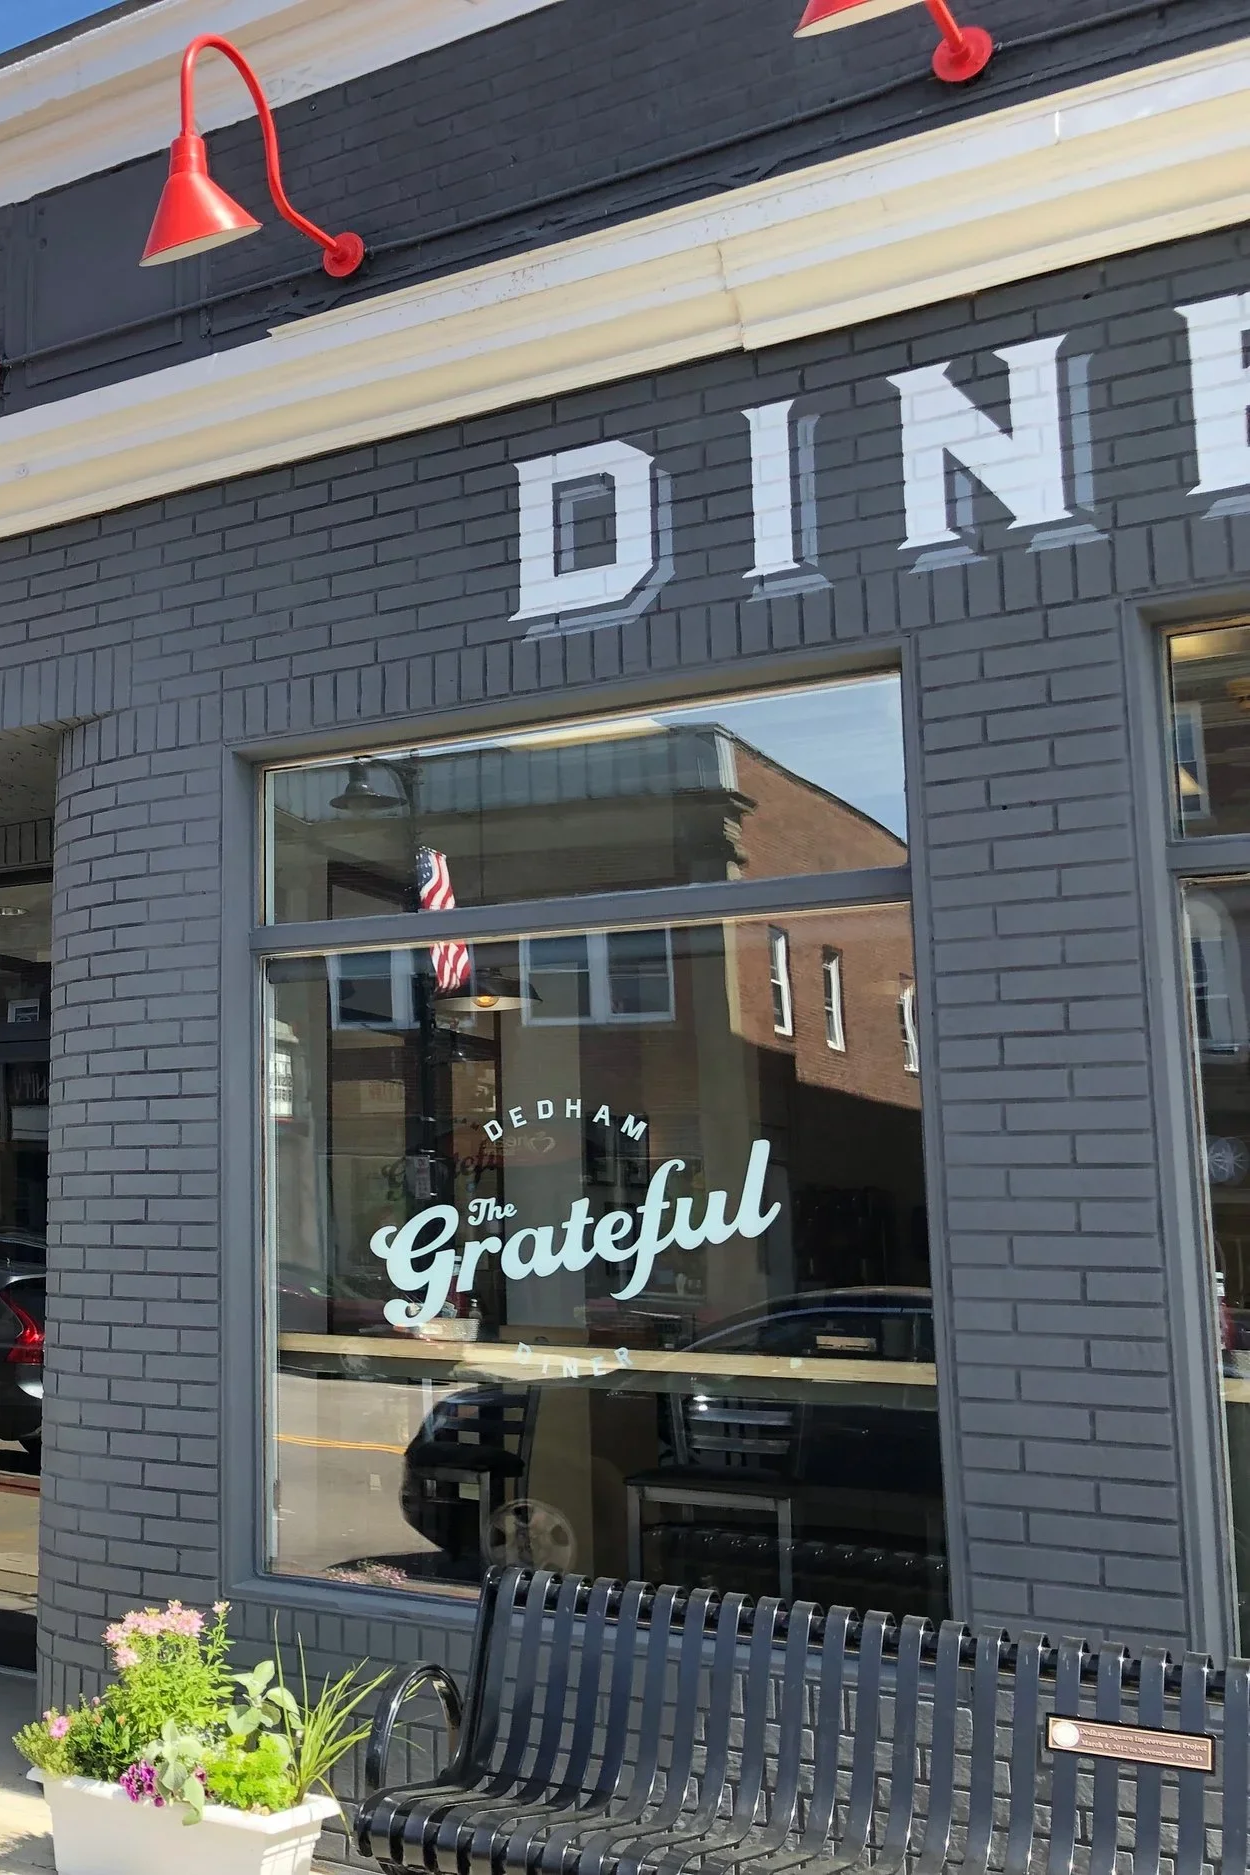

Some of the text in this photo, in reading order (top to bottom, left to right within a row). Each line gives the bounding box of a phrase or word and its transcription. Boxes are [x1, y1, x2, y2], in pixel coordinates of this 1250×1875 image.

[482, 1098, 648, 1143] DEDHAM
[467, 1197, 518, 1226] The
[369, 1139, 782, 1327] Grateful
[514, 1341, 634, 1379] DINER
[1079, 1728, 1208, 1752] Dedham Square Improvement Project
[1081, 1739, 1103, 1749] March
